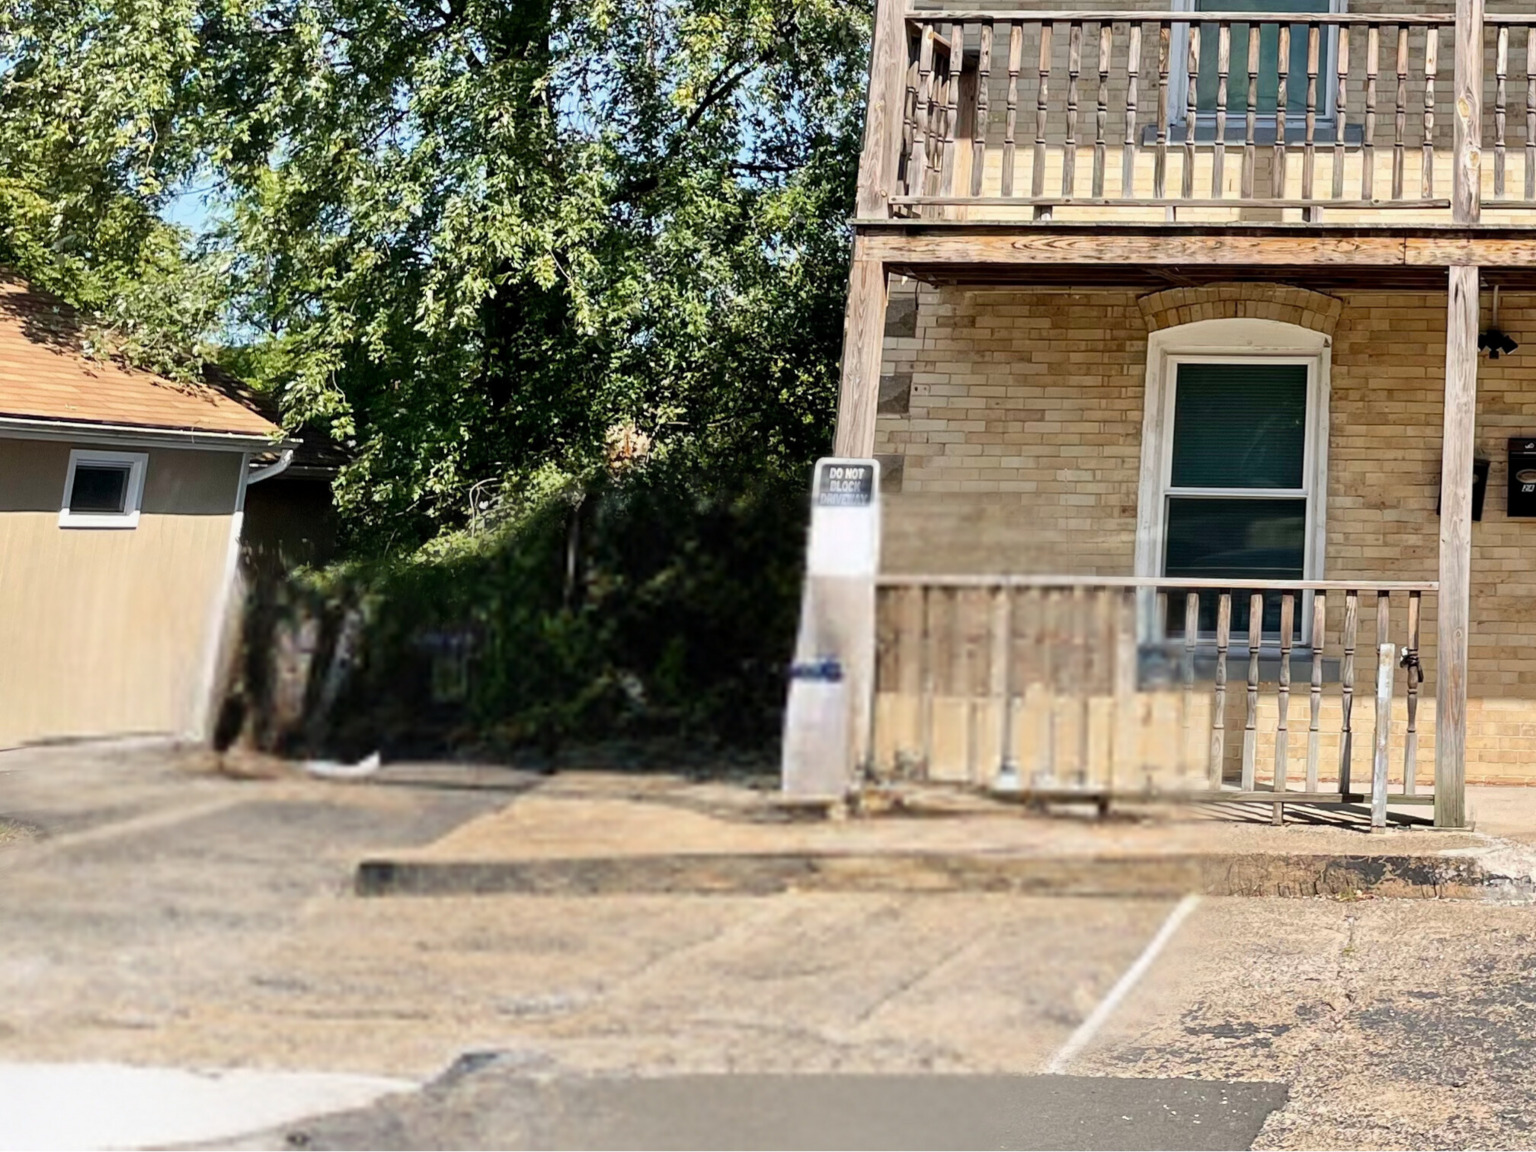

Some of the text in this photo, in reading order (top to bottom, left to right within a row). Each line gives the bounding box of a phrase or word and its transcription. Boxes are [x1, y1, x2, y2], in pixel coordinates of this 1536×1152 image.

[829, 467, 865, 480] DO NOT
[829, 481, 861, 493] BLOCK
